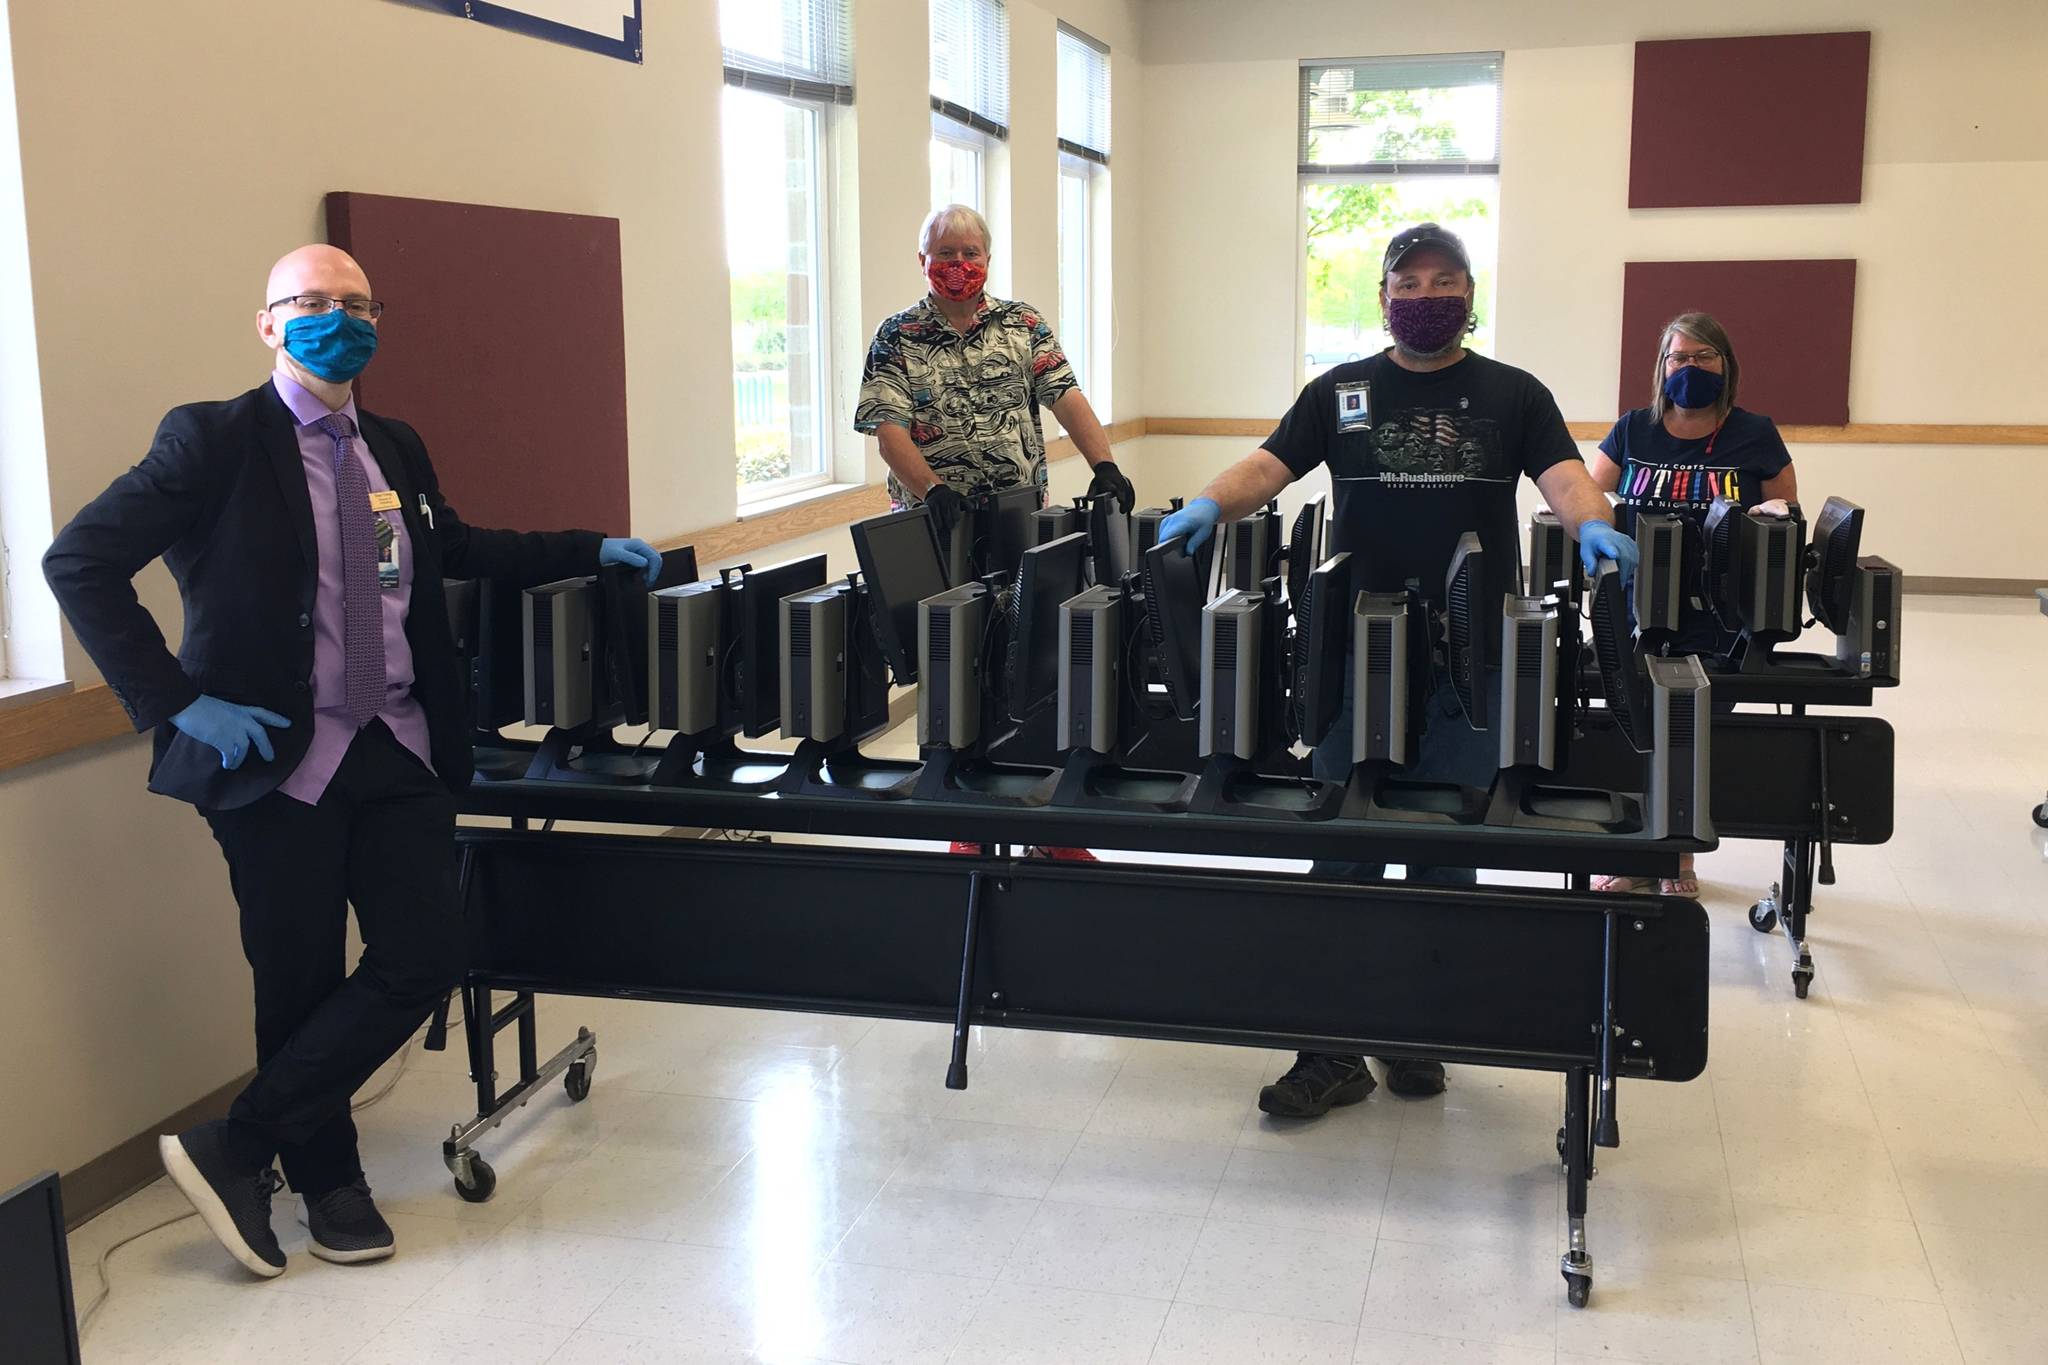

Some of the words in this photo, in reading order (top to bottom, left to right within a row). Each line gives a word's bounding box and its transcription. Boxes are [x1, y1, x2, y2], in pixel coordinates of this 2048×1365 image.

[1673, 463, 1704, 471] COSTS
[1618, 464, 1740, 502] NOTHING
[1628, 498, 1641, 506] BE
